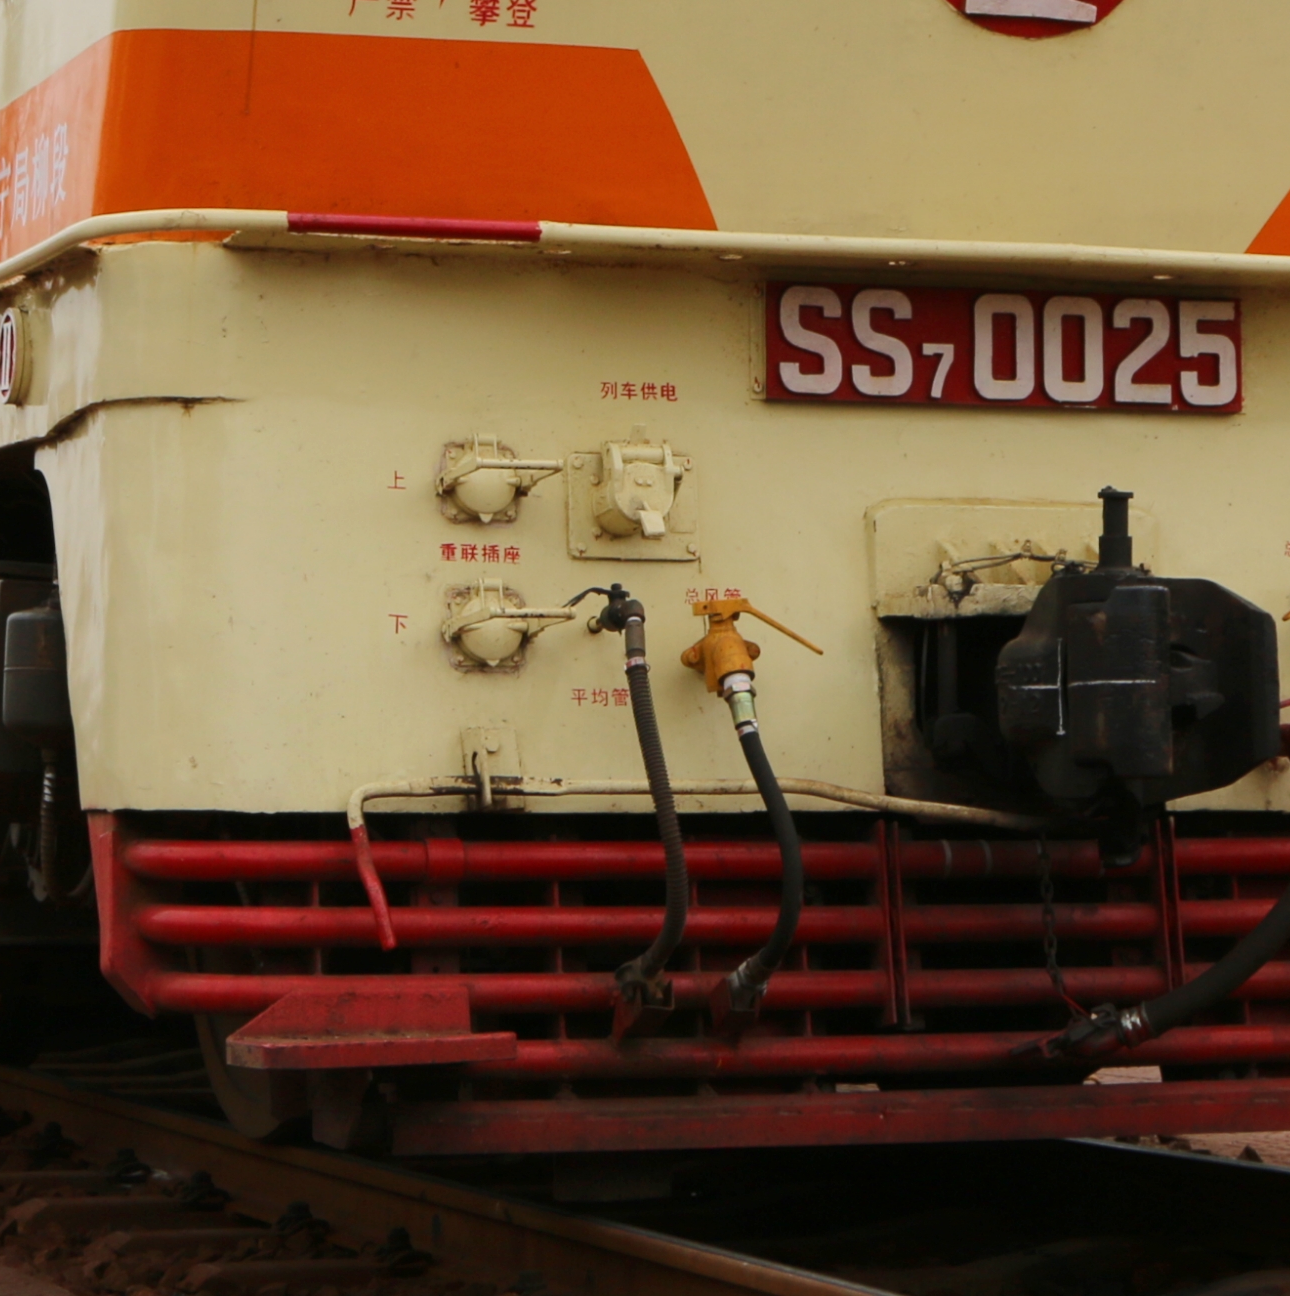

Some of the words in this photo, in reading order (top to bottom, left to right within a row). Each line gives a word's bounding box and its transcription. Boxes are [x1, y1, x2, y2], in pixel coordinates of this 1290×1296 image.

[600, 381, 678, 402] 列车供电
[387, 471, 407, 490] 上
[440, 543, 521, 564] 重联插座
[388, 614, 407, 634] 下
[571, 688, 629, 707] 平均管
